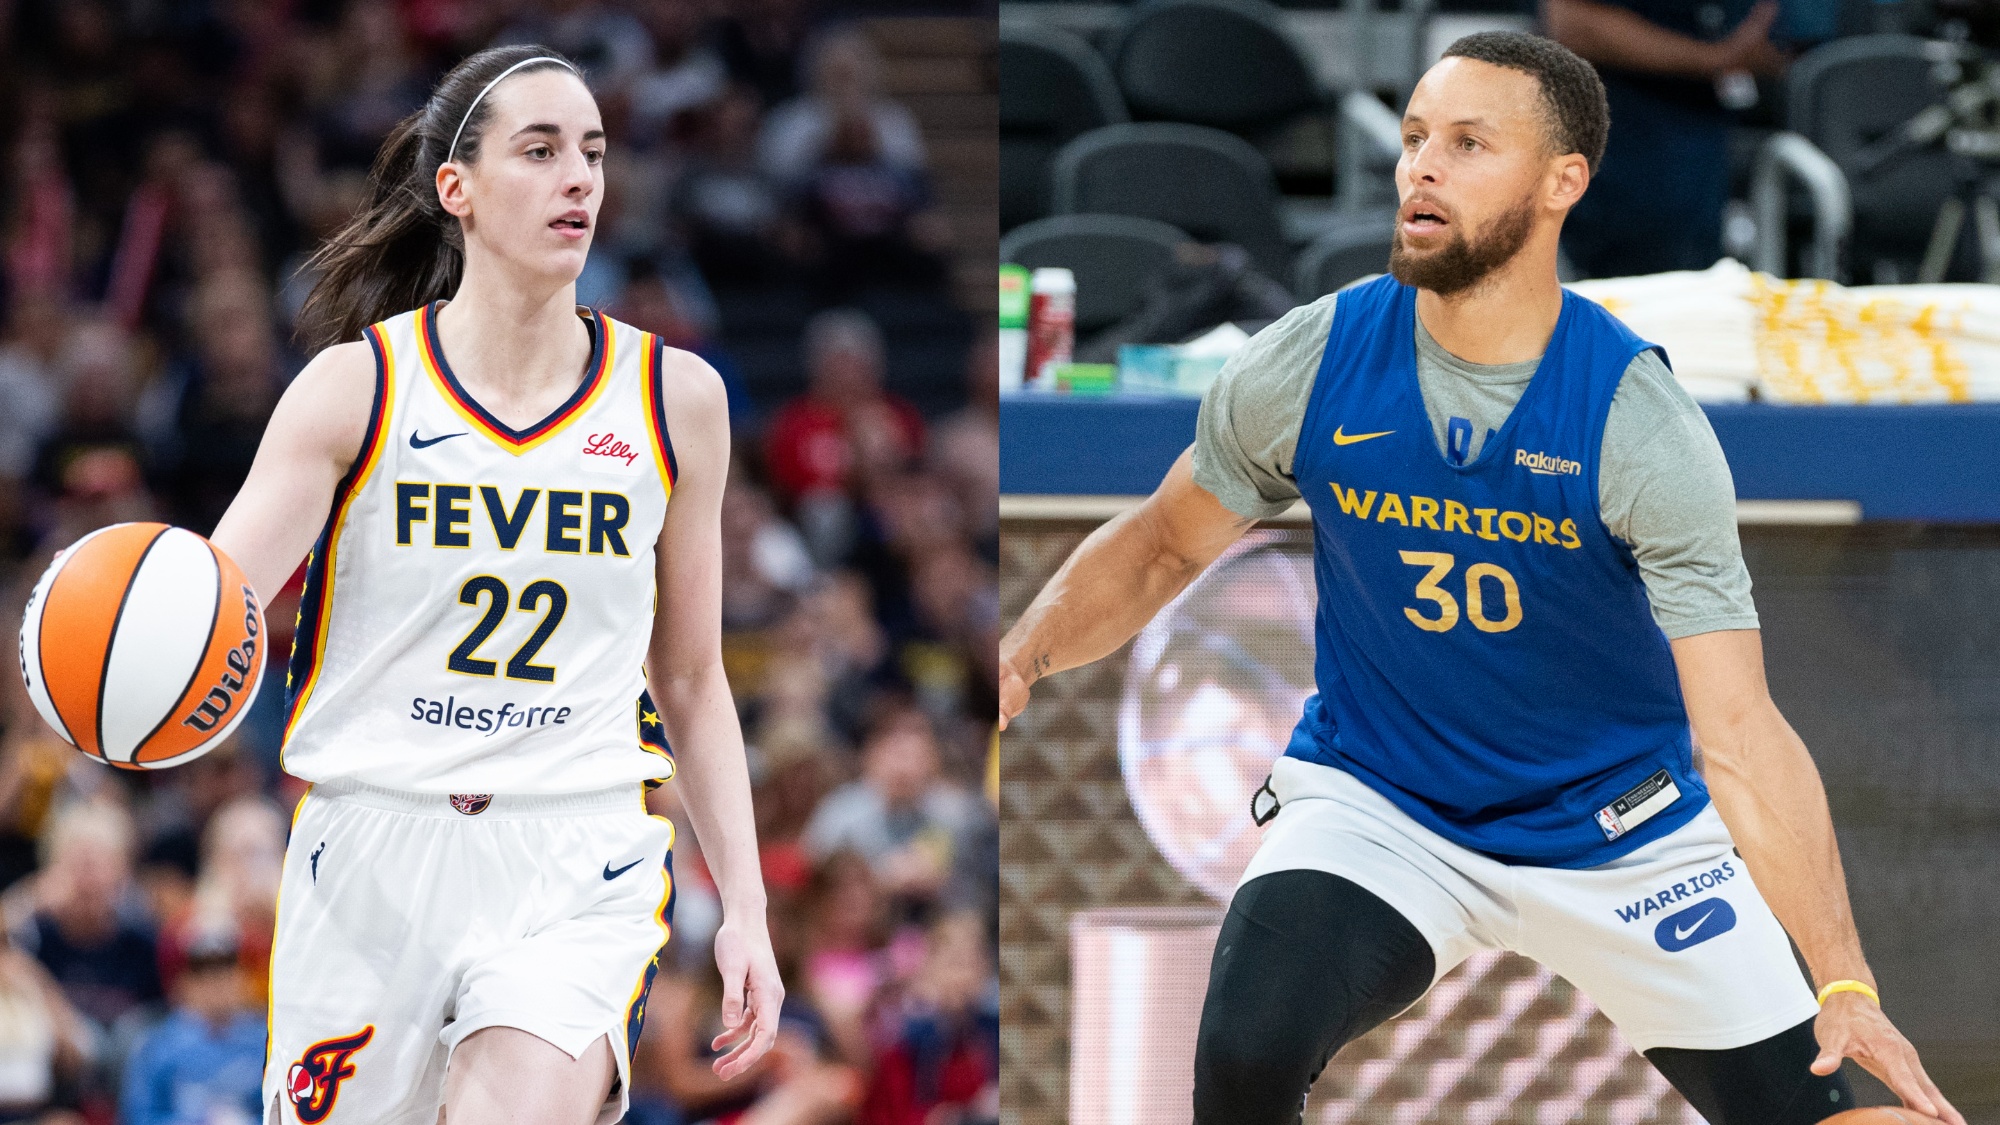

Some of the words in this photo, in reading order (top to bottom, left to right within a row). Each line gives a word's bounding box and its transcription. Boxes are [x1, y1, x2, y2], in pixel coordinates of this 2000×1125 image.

[582, 432, 639, 467] Lilly
[1514, 448, 1582, 476] Rakuten
[395, 481, 633, 558] FEVER
[1328, 481, 1582, 550] WARRIORS
[1398, 549, 1524, 633] 30
[182, 583, 259, 733] Wilson
[445, 573, 570, 684] 22
[410, 695, 572, 738] salesforce
[1613, 860, 1736, 924] WARRIORS
